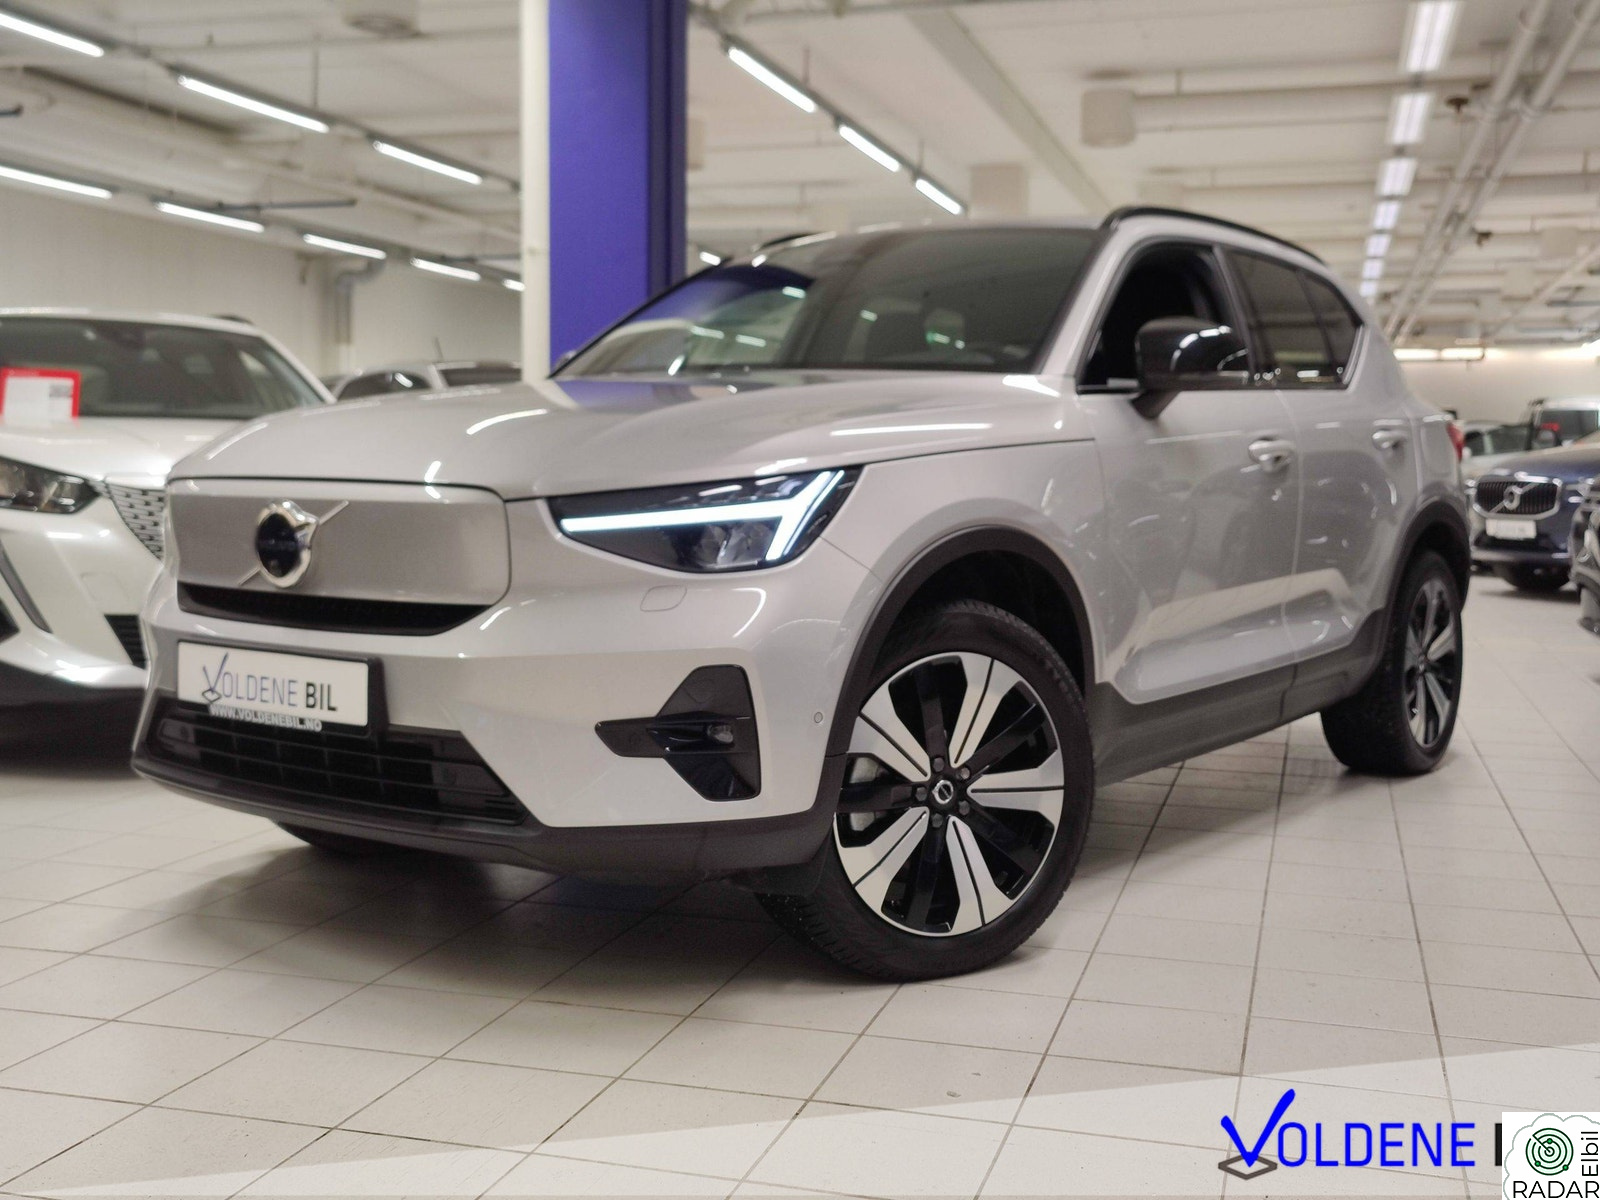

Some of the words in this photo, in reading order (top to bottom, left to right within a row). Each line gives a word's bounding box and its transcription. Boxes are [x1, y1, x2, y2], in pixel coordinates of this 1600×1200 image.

[203, 652, 298, 707] VOLDENE
[305, 681, 338, 712] BIL
[209, 703, 323, 732] WWW.VOLDENEBIL.NO
